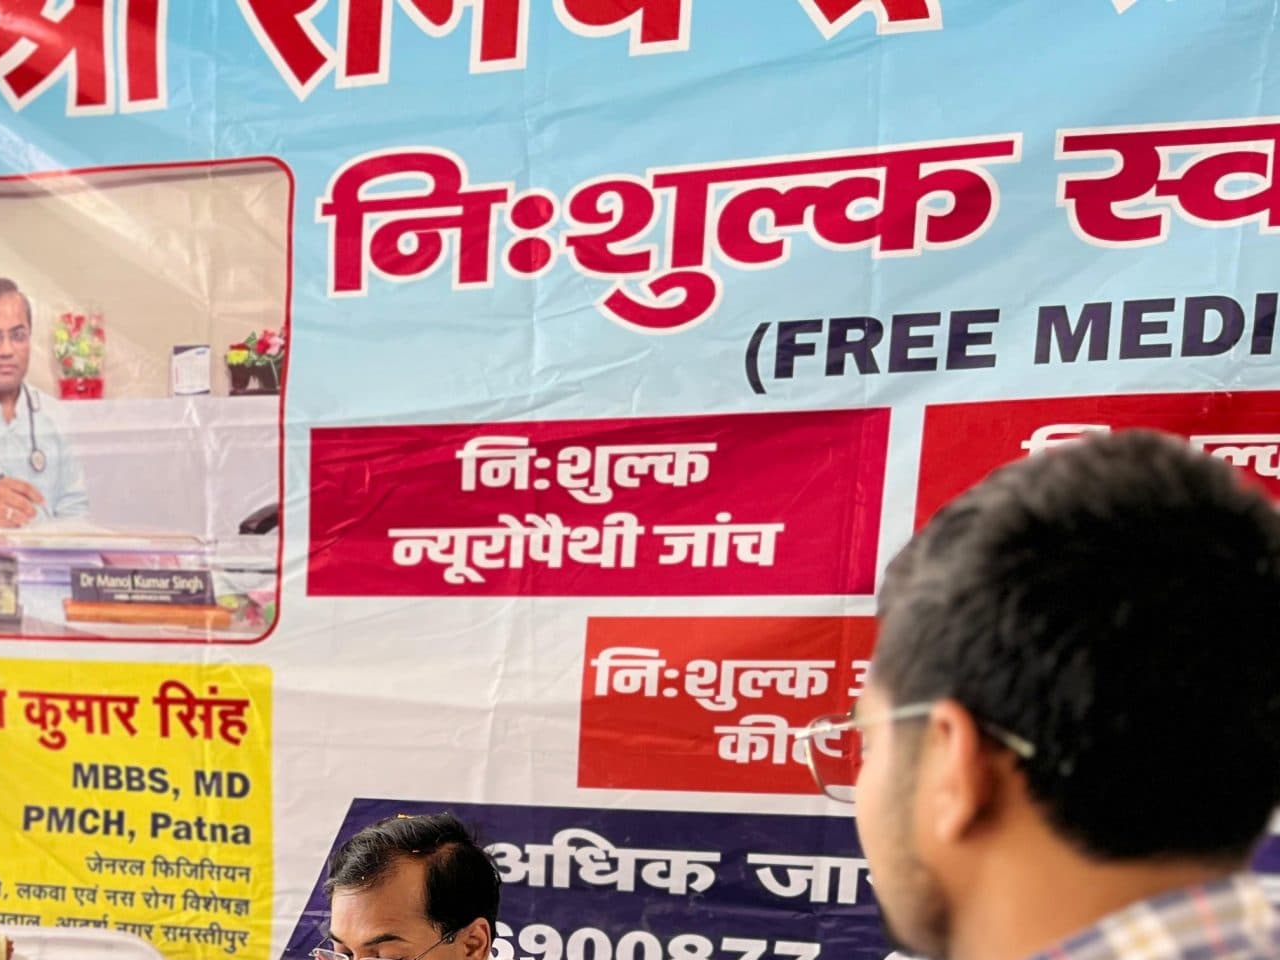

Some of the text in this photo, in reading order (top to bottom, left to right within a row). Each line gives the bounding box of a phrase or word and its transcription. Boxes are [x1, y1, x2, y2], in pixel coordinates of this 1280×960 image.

[744, 308, 1000, 393] (FREE
[388, 512, 784, 584] न्यूरोपैथी जांच
[80, 573, 203, 592] Dr Manoj Kumar Singh
[18, 687, 140, 751] कुमार
[154, 680, 249, 746] सिंह
[71, 762, 251, 801] MBBS, MD
[22, 805, 252, 845] PMCH, Patna
[85, 851, 251, 883] जेनरल फिजिसियन
[482, 827, 876, 904] अधिक जा
[15, 882, 66, 903] लकवा
[73, 884, 98, 907] एवं
[104, 889, 136, 908] नस
[143, 886, 176, 911] रोग
